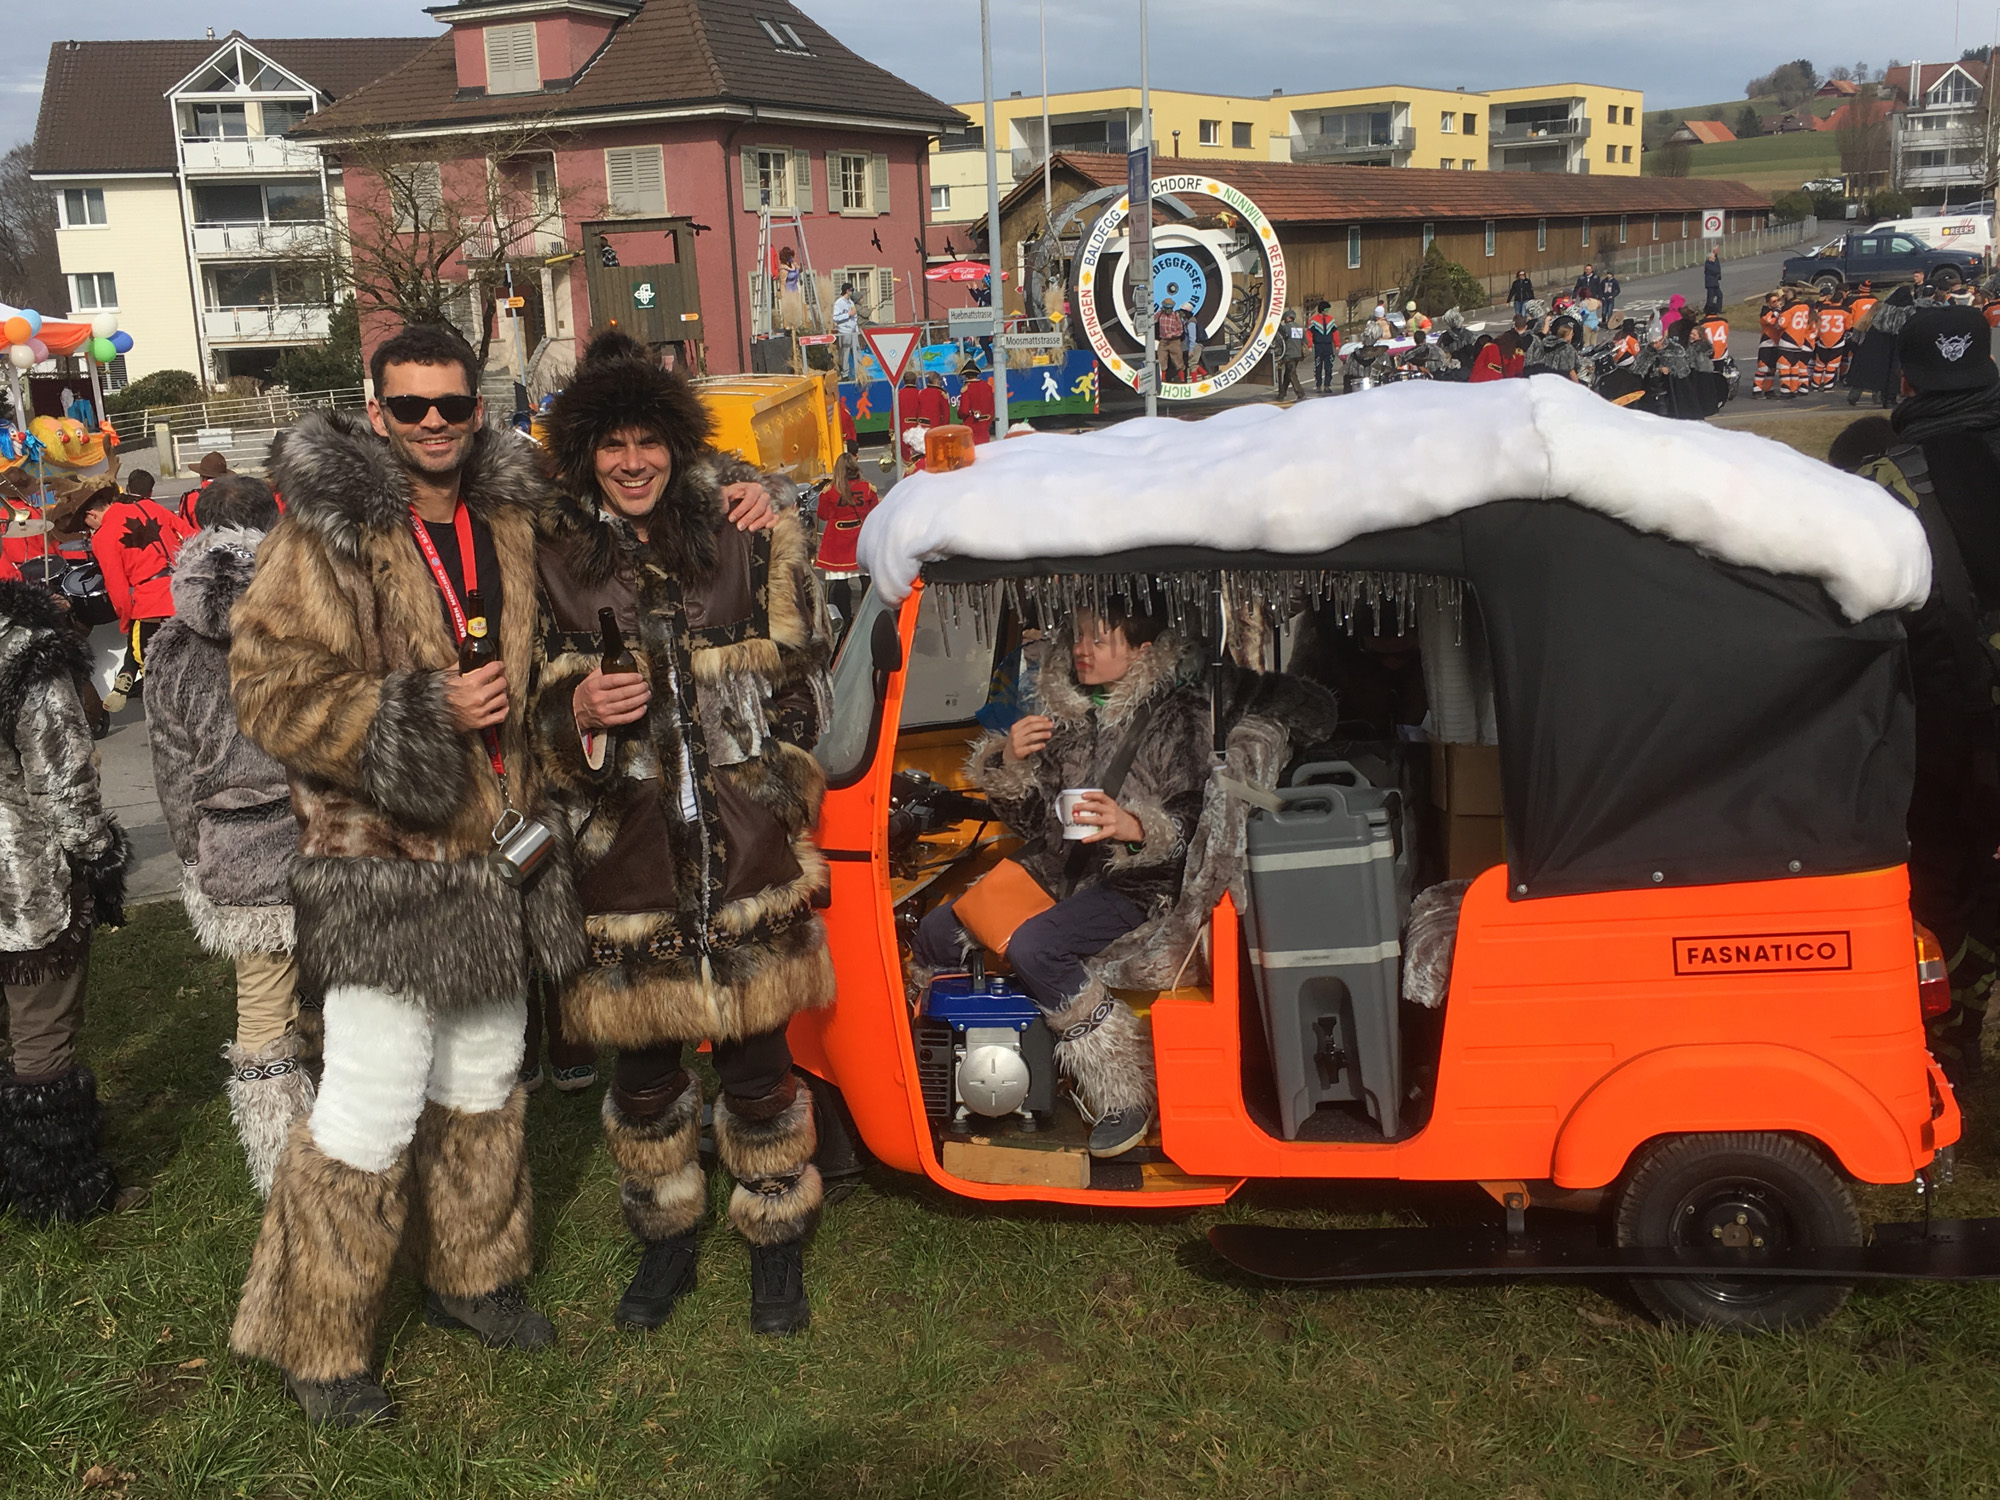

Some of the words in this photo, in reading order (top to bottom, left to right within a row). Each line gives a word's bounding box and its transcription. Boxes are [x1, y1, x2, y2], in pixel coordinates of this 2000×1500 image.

[1151, 177, 1203, 194] CHDORF
[1223, 187, 1262, 227] NUNWIL
[1084, 209, 1121, 266] BALDEGG
[1267, 243, 1285, 318] RETSCHWIL
[1081, 289, 1113, 359] GELFINGEN
[1705, 325, 1727, 344] 14
[1820, 314, 1844, 333] 33
[1005, 336, 1061, 346] Moosmattstrasse
[452, 607, 467, 638] BAYERN
[1686, 942, 1837, 965] FASNATICO
